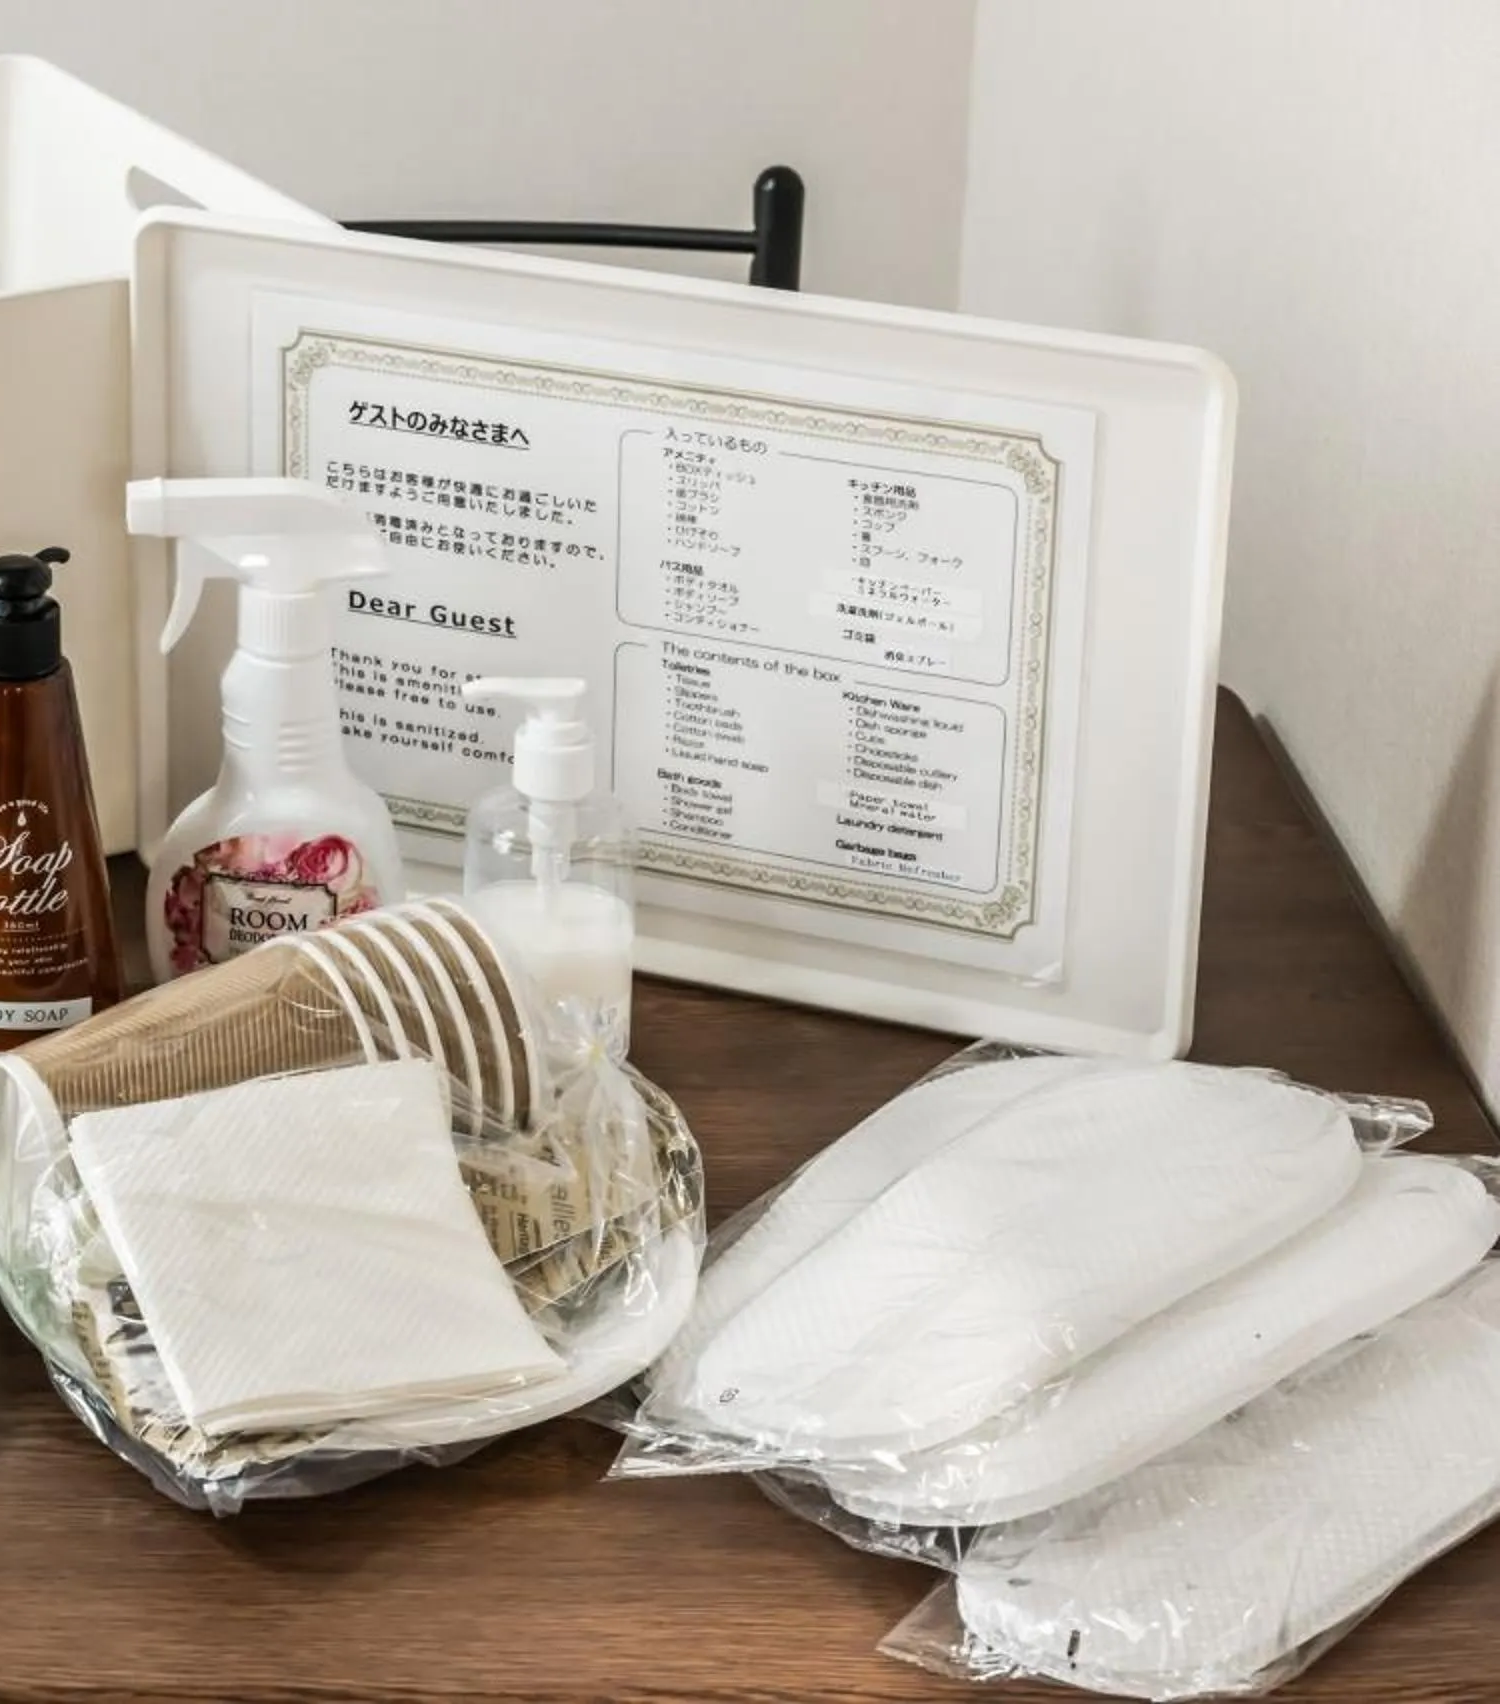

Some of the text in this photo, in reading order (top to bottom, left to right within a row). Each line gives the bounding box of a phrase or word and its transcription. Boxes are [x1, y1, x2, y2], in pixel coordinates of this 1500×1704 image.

[349, 401, 530, 446] ゲストのみなさまへ
[665, 427, 768, 455] 入っているもの
[349, 591, 516, 635] Dear Guest
[333, 661, 369, 681] his
[373, 670, 387, 684] is
[392, 661, 422, 677] you
[431, 664, 457, 681] for
[662, 641, 841, 683] The contents of the box
[334, 678, 385, 699] lease
[395, 690, 430, 706] free
[439, 696, 457, 711] to
[890, 698, 921, 712] Ware
[339, 708, 485, 745] his is sanitized.
[341, 724, 373, 743] ake
[461, 747, 516, 766] comfo
[836, 813, 884, 832] Laundry
[230, 907, 309, 932] ROOM
[230, 928, 277, 944] DEODO
[24, 1007, 69, 1022] SOAP
